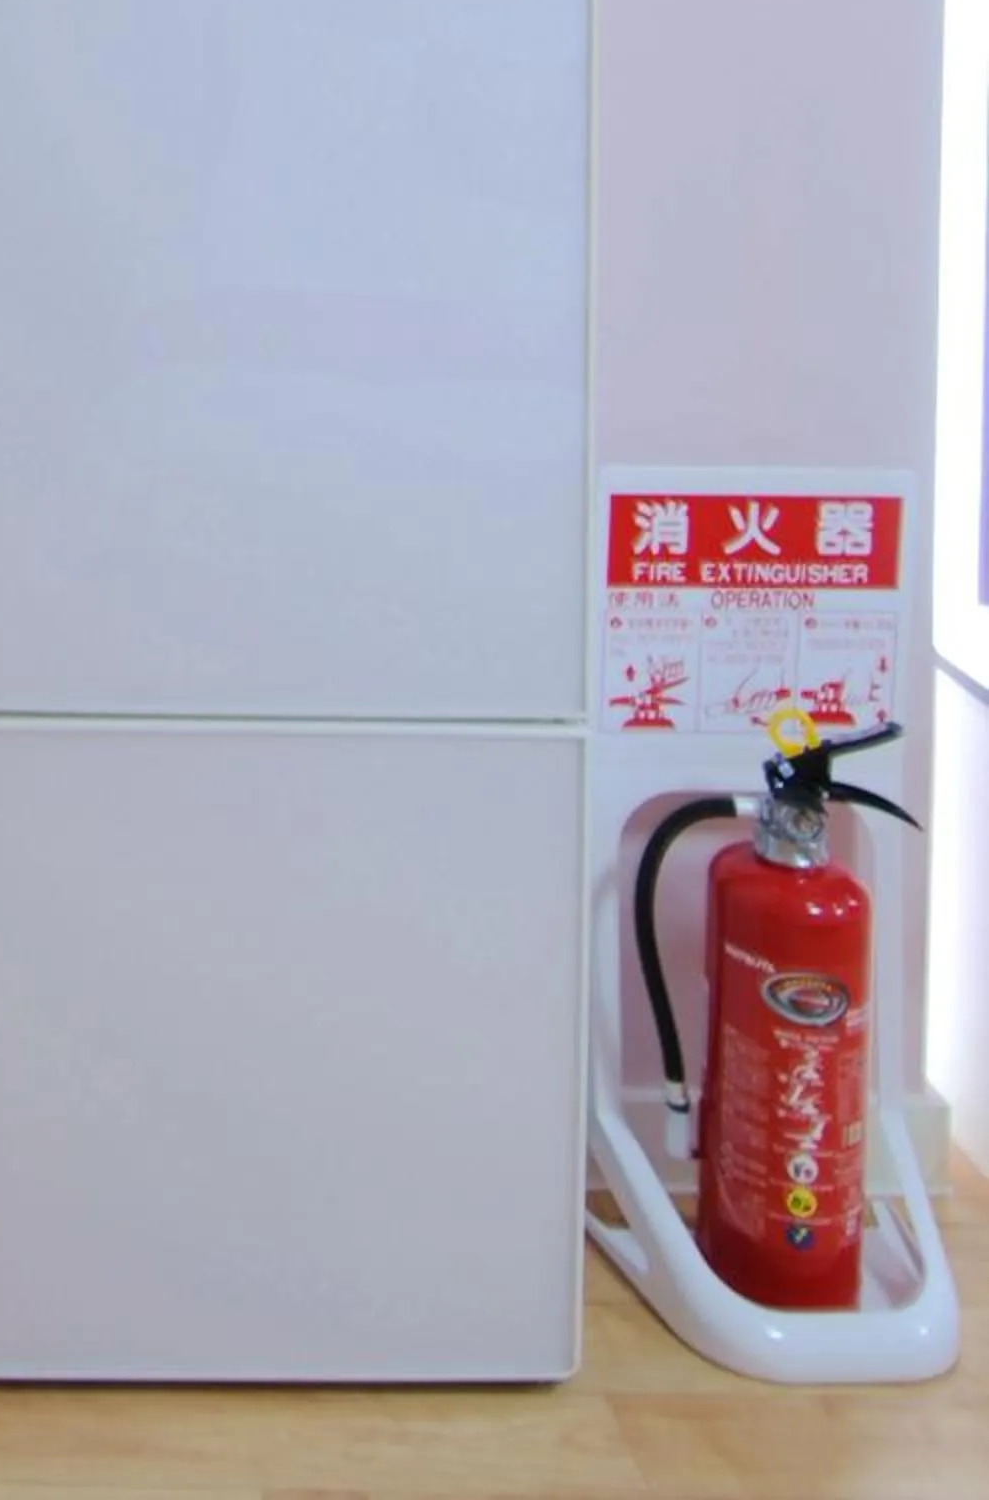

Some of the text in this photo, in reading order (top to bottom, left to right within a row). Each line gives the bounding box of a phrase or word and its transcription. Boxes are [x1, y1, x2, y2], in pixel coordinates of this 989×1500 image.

[631, 498, 874, 557] 消火器
[632, 562, 869, 584] FIRE EXTINGUISHER
[710, 590, 816, 611] OPERATION
